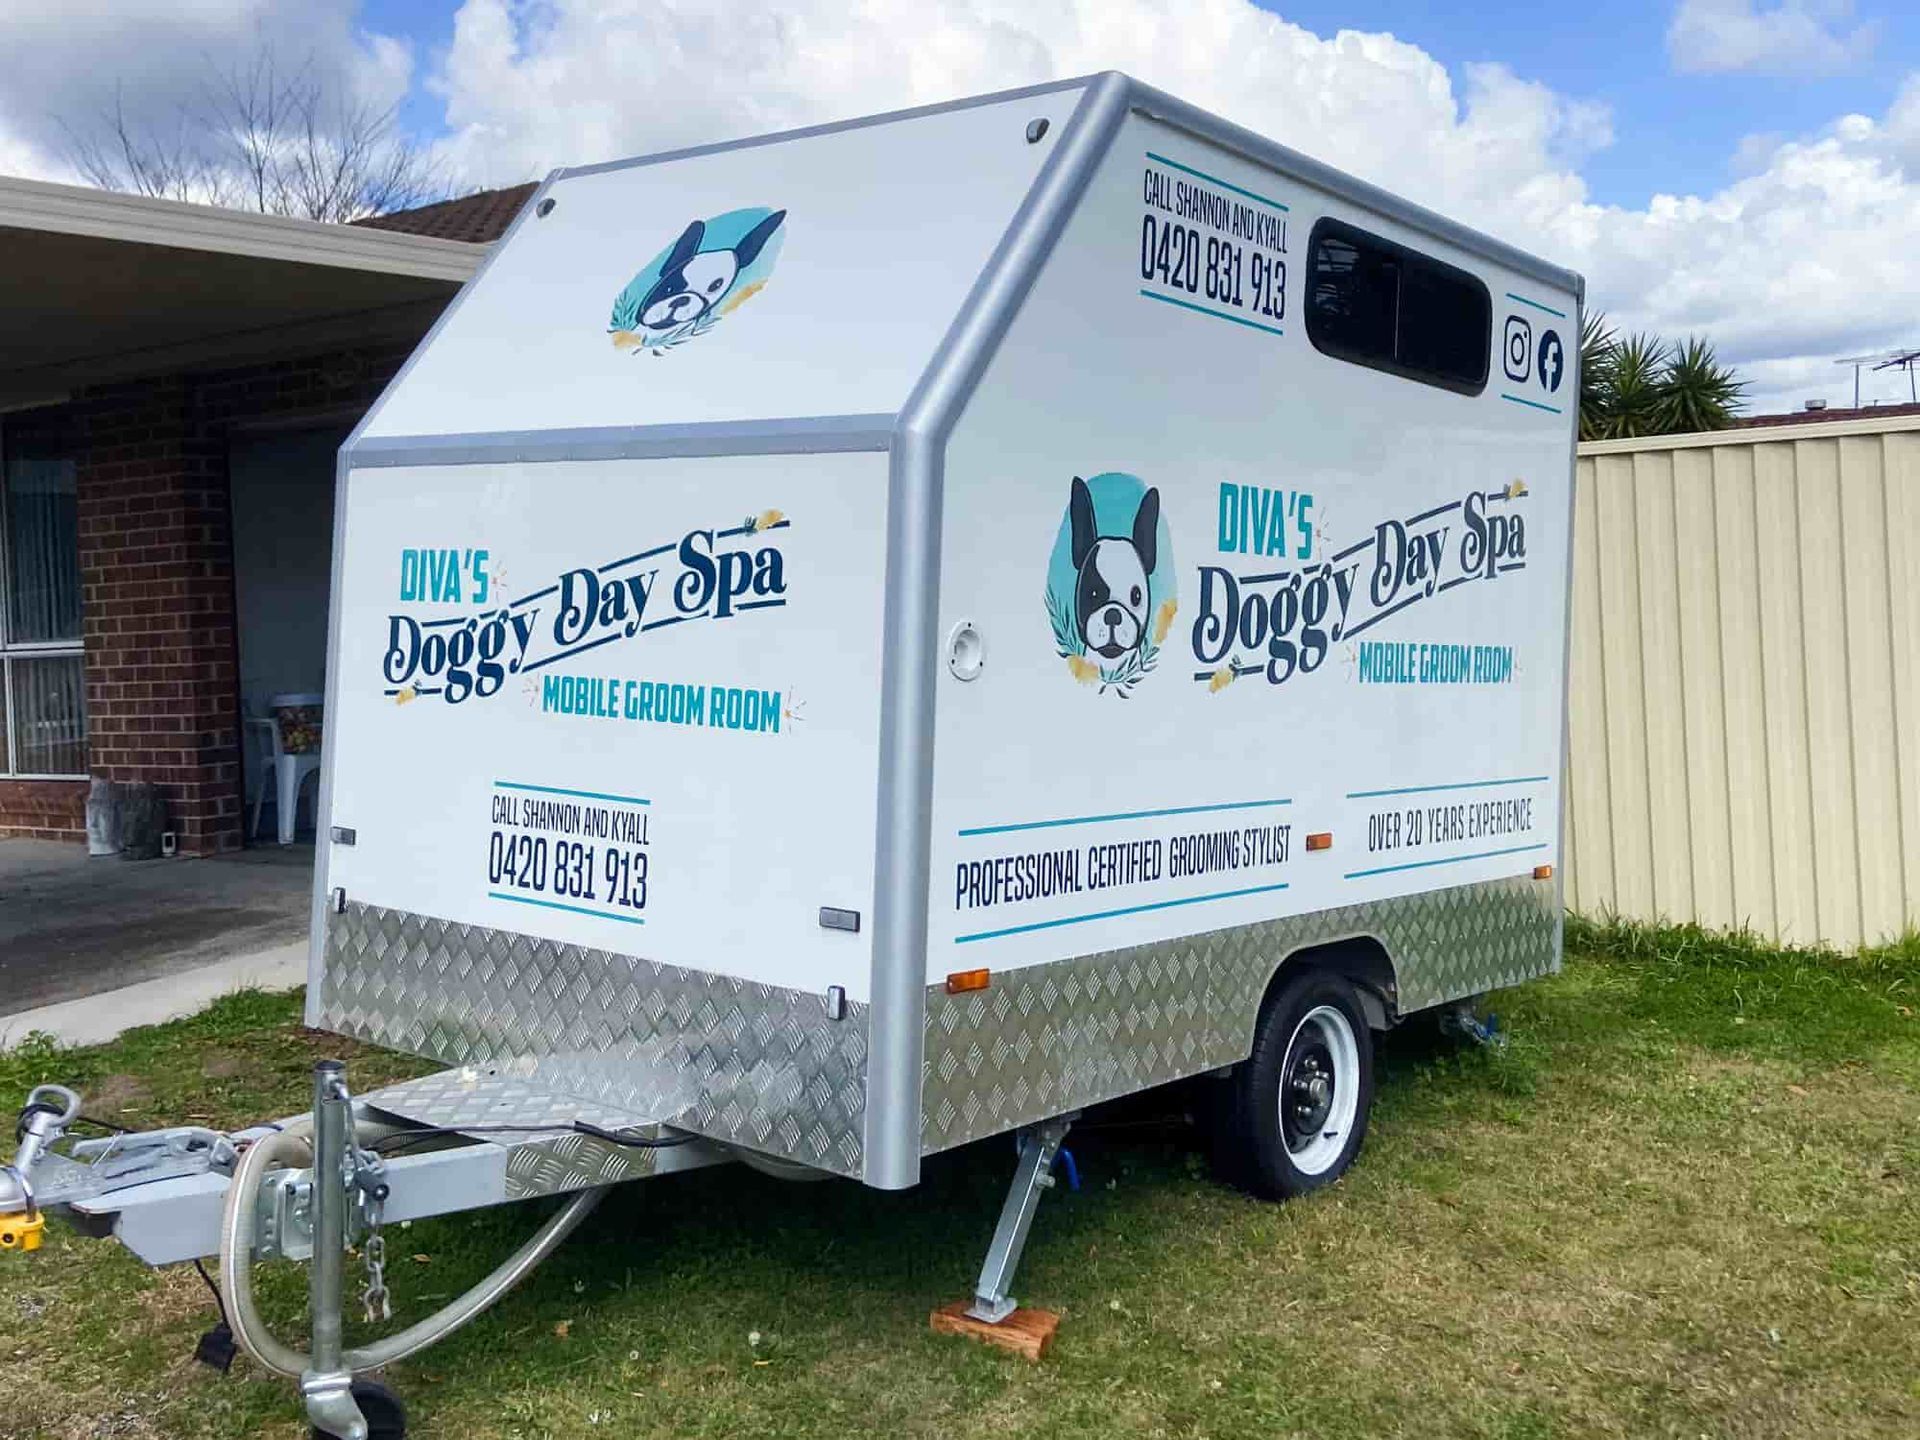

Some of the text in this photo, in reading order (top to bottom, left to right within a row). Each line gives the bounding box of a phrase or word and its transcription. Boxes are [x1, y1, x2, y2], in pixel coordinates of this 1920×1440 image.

[1144, 168, 1288, 254] CALL SHANNON AND KYALL
[1141, 214, 1286, 320] 0420 831 913
[1218, 482, 1313, 559] DIVA'S
[401, 549, 489, 603] DIVA'S
[1193, 491, 1527, 685] Doggy Day Spa
[383, 530, 787, 703] Doggy Day Spa
[1359, 642, 1513, 684] MOBILE GROOM ROOM
[543, 675, 781, 733] MOBILE GROOM ROOM
[492, 795, 650, 845] CALL SHANNON AND KYALL
[1368, 798, 1533, 853] OVER 20 YEARS EXPERIENCE
[489, 832, 647, 909] 0420 831 913
[956, 825, 1291, 910] PROFESSIONAL CERTIFIED GROOMING STYLIST
